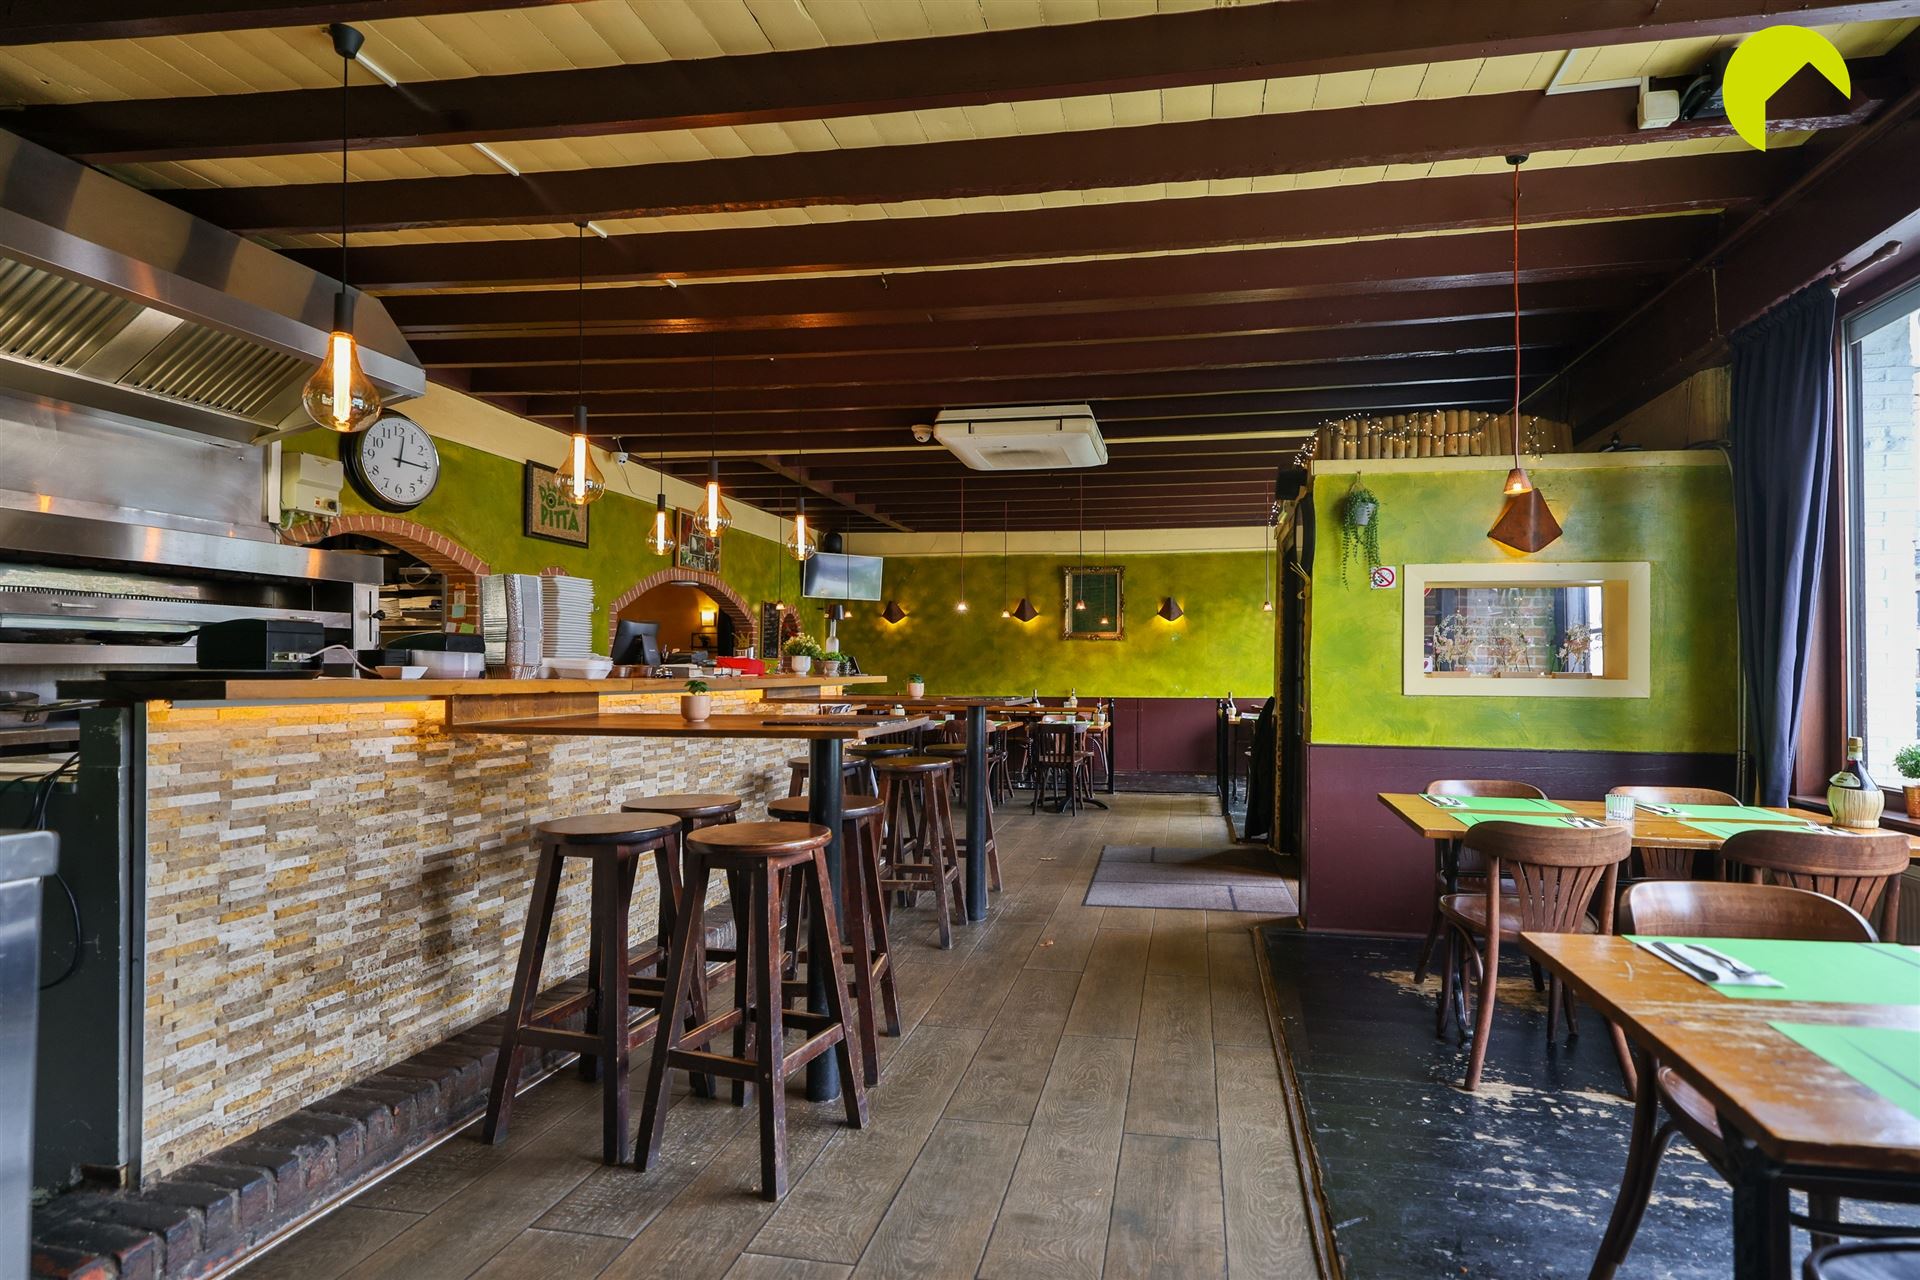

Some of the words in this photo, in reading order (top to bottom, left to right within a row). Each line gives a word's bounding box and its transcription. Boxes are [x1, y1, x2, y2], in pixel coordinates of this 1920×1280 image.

[382, 428, 390, 439] 11
[394, 426, 405, 437] 12
[372, 437, 384, 448] 10
[367, 448, 375, 460] 9
[417, 446, 424, 456] 2
[372, 465, 379, 475] 8
[383, 477, 390, 488] 7
[417, 475, 423, 484] 4
[394, 484, 402, 494] 6
[409, 483, 416, 493] 5
[541, 504, 580, 532] PITTA
